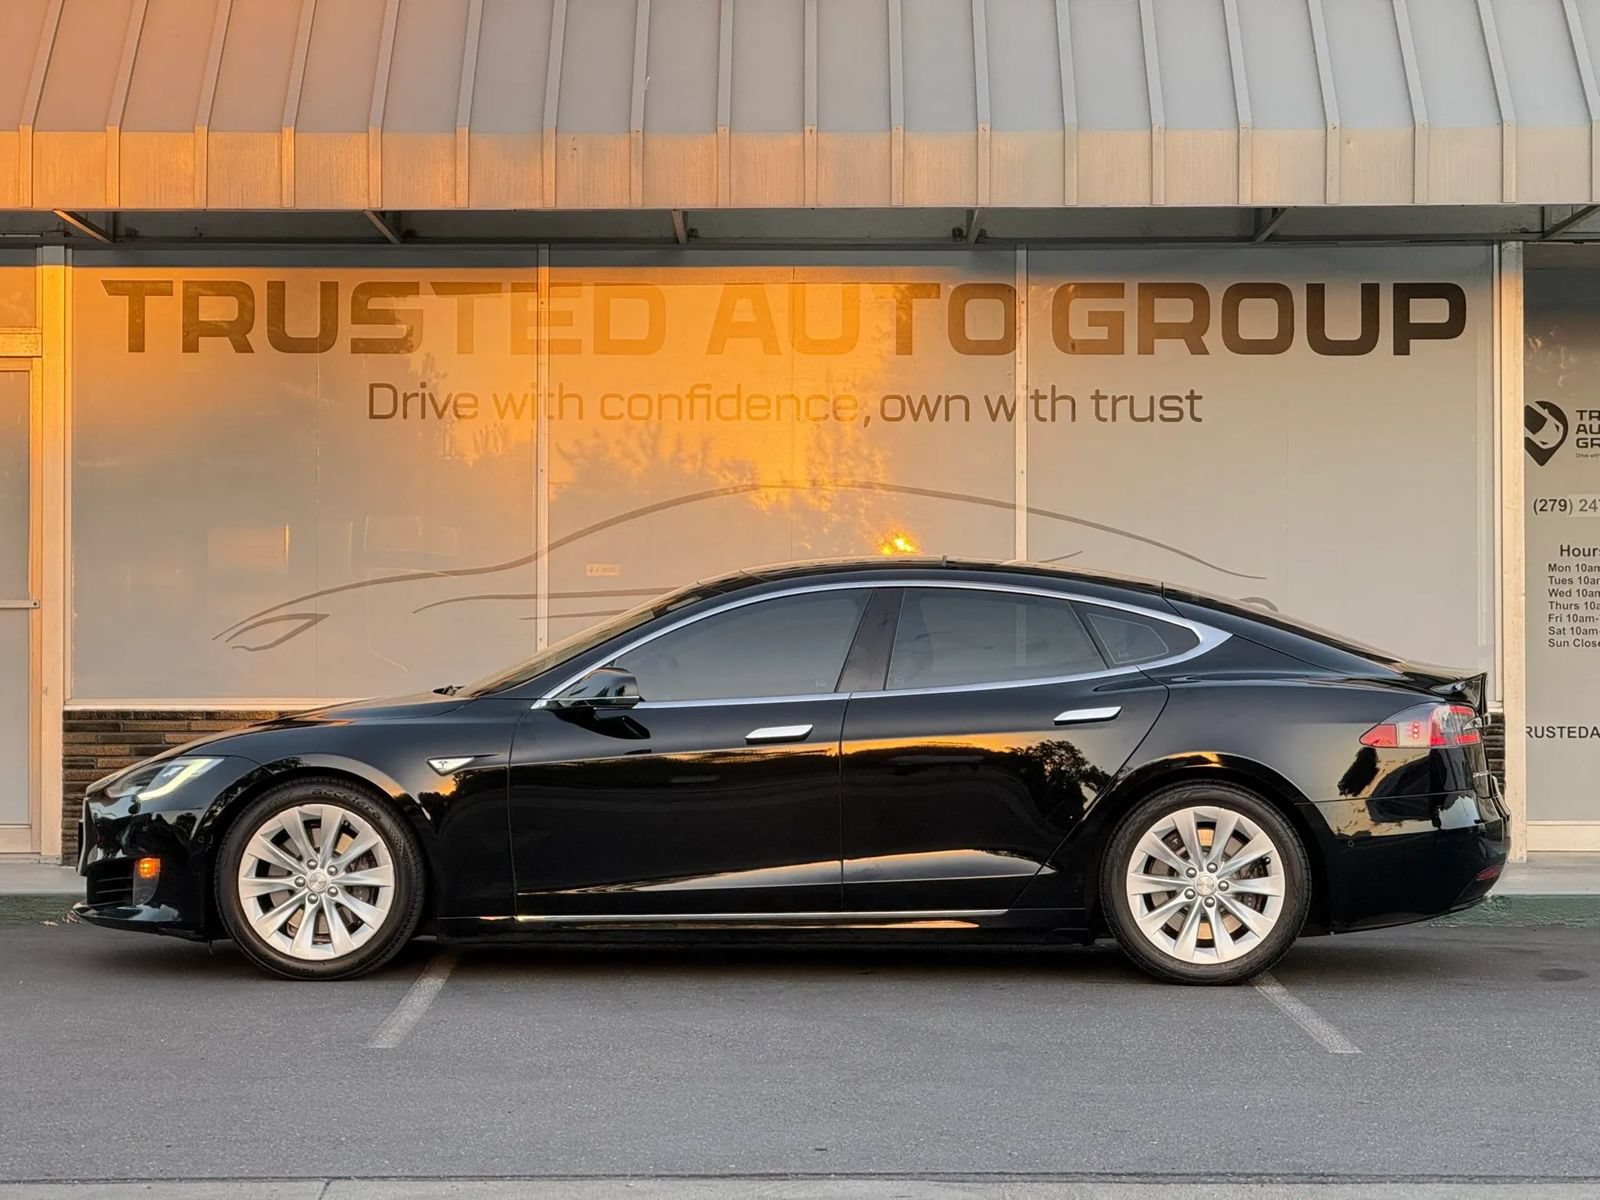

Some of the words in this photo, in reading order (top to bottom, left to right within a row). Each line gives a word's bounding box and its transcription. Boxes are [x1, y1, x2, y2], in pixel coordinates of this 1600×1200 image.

[101, 280, 666, 355] TRUSTED
[706, 282, 1016, 355] AUTO
[1052, 282, 1467, 355] GROUP
[368, 382, 479, 420] Drive
[600, 382, 870, 427] confidence,
[880, 394, 970, 422] own
[984, 384, 1076, 422] wth
[1090, 388, 1204, 423] trust
[1533, 498, 1573, 516] (279)
[1579, 498, 1600, 512] 24
[1560, 544, 1600, 557] Hour
[1548, 564, 1572, 573] Mon
[1548, 575, 1574, 585] Tues
[1548, 588, 1572, 598] Wed
[1548, 601, 1580, 610] Thurs
[1548, 613, 1563, 623] Fri
[1548, 626, 1566, 636] Sat
[1548, 638, 1570, 648] Sun
